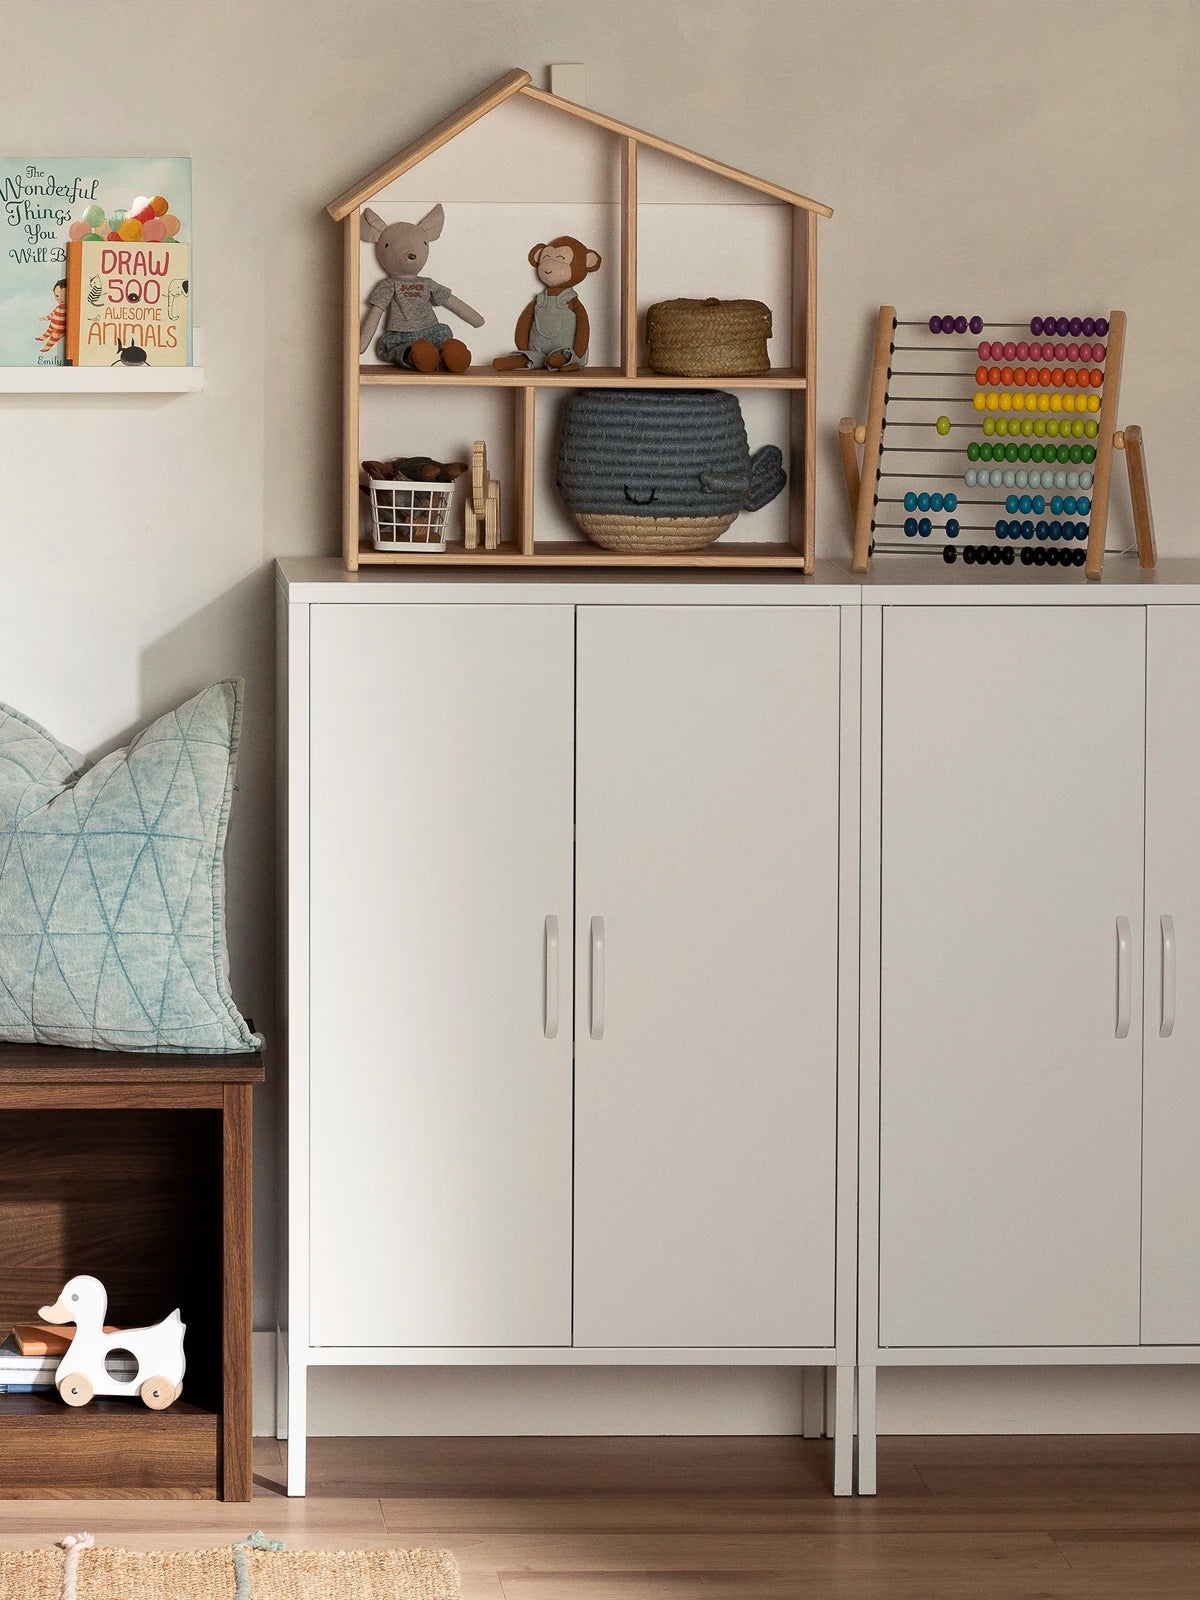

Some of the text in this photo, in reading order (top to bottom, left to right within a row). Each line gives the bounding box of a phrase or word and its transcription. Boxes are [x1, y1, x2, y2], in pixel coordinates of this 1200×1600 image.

[25, 165, 45, 179] The
[5, 199, 72, 226] Things
[24, 224, 57, 244] You
[8, 247, 67, 264] Will B
[101, 249, 170, 277] DRAW
[107, 279, 161, 304] 500
[104, 306, 162, 321] AWESOME
[87, 322, 178, 348] ANIMALS
[37, 355, 62, 367] Emily
